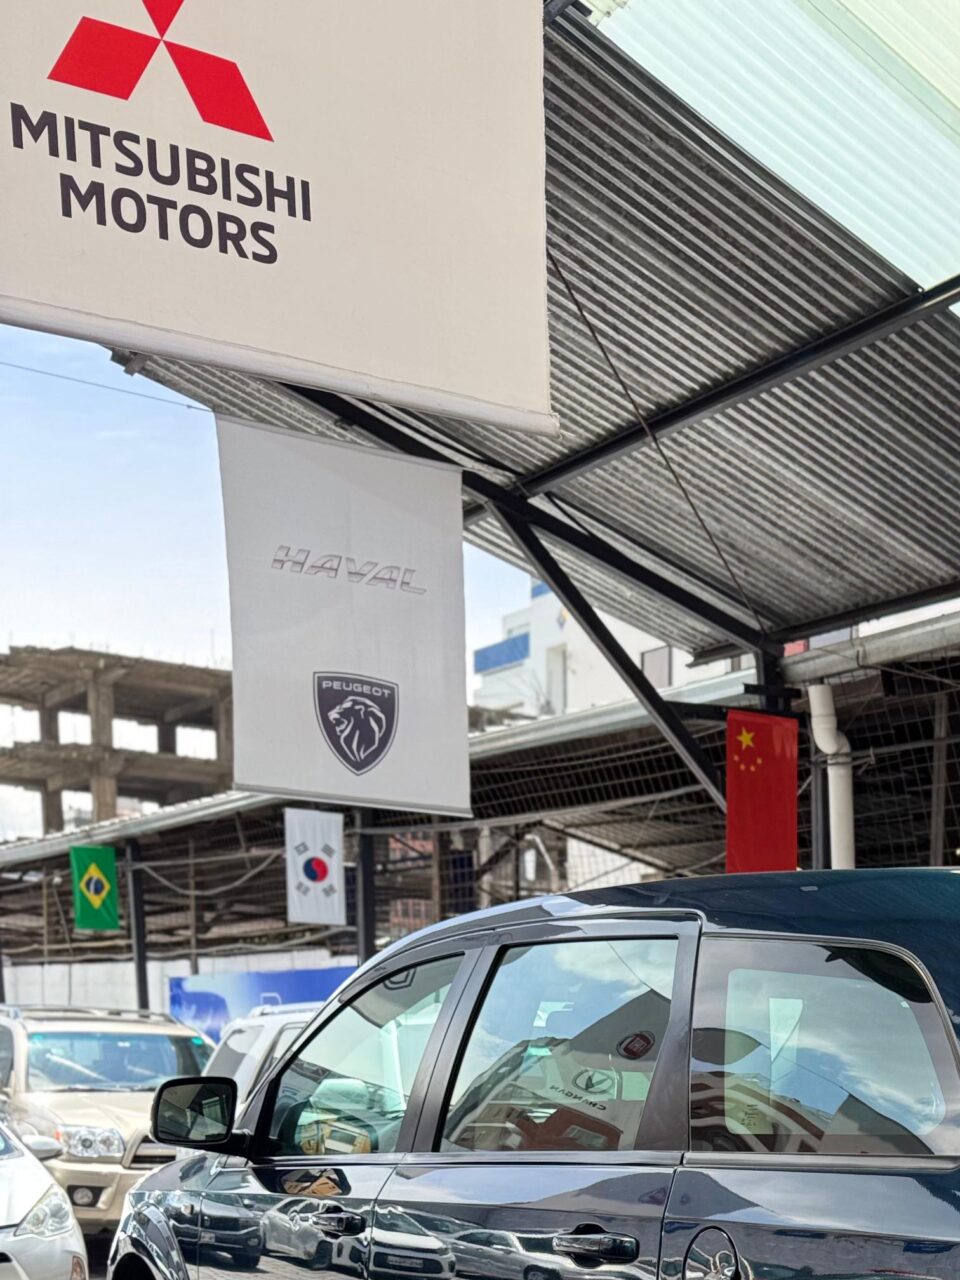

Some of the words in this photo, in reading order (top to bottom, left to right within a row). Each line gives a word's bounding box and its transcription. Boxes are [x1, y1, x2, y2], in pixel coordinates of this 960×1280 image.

[10, 102, 312, 222] MITSUBISHI
[60, 172, 279, 265] MOTORS
[271, 545, 428, 596] HAVAL
[322, 681, 391, 698] PEUGEOT
